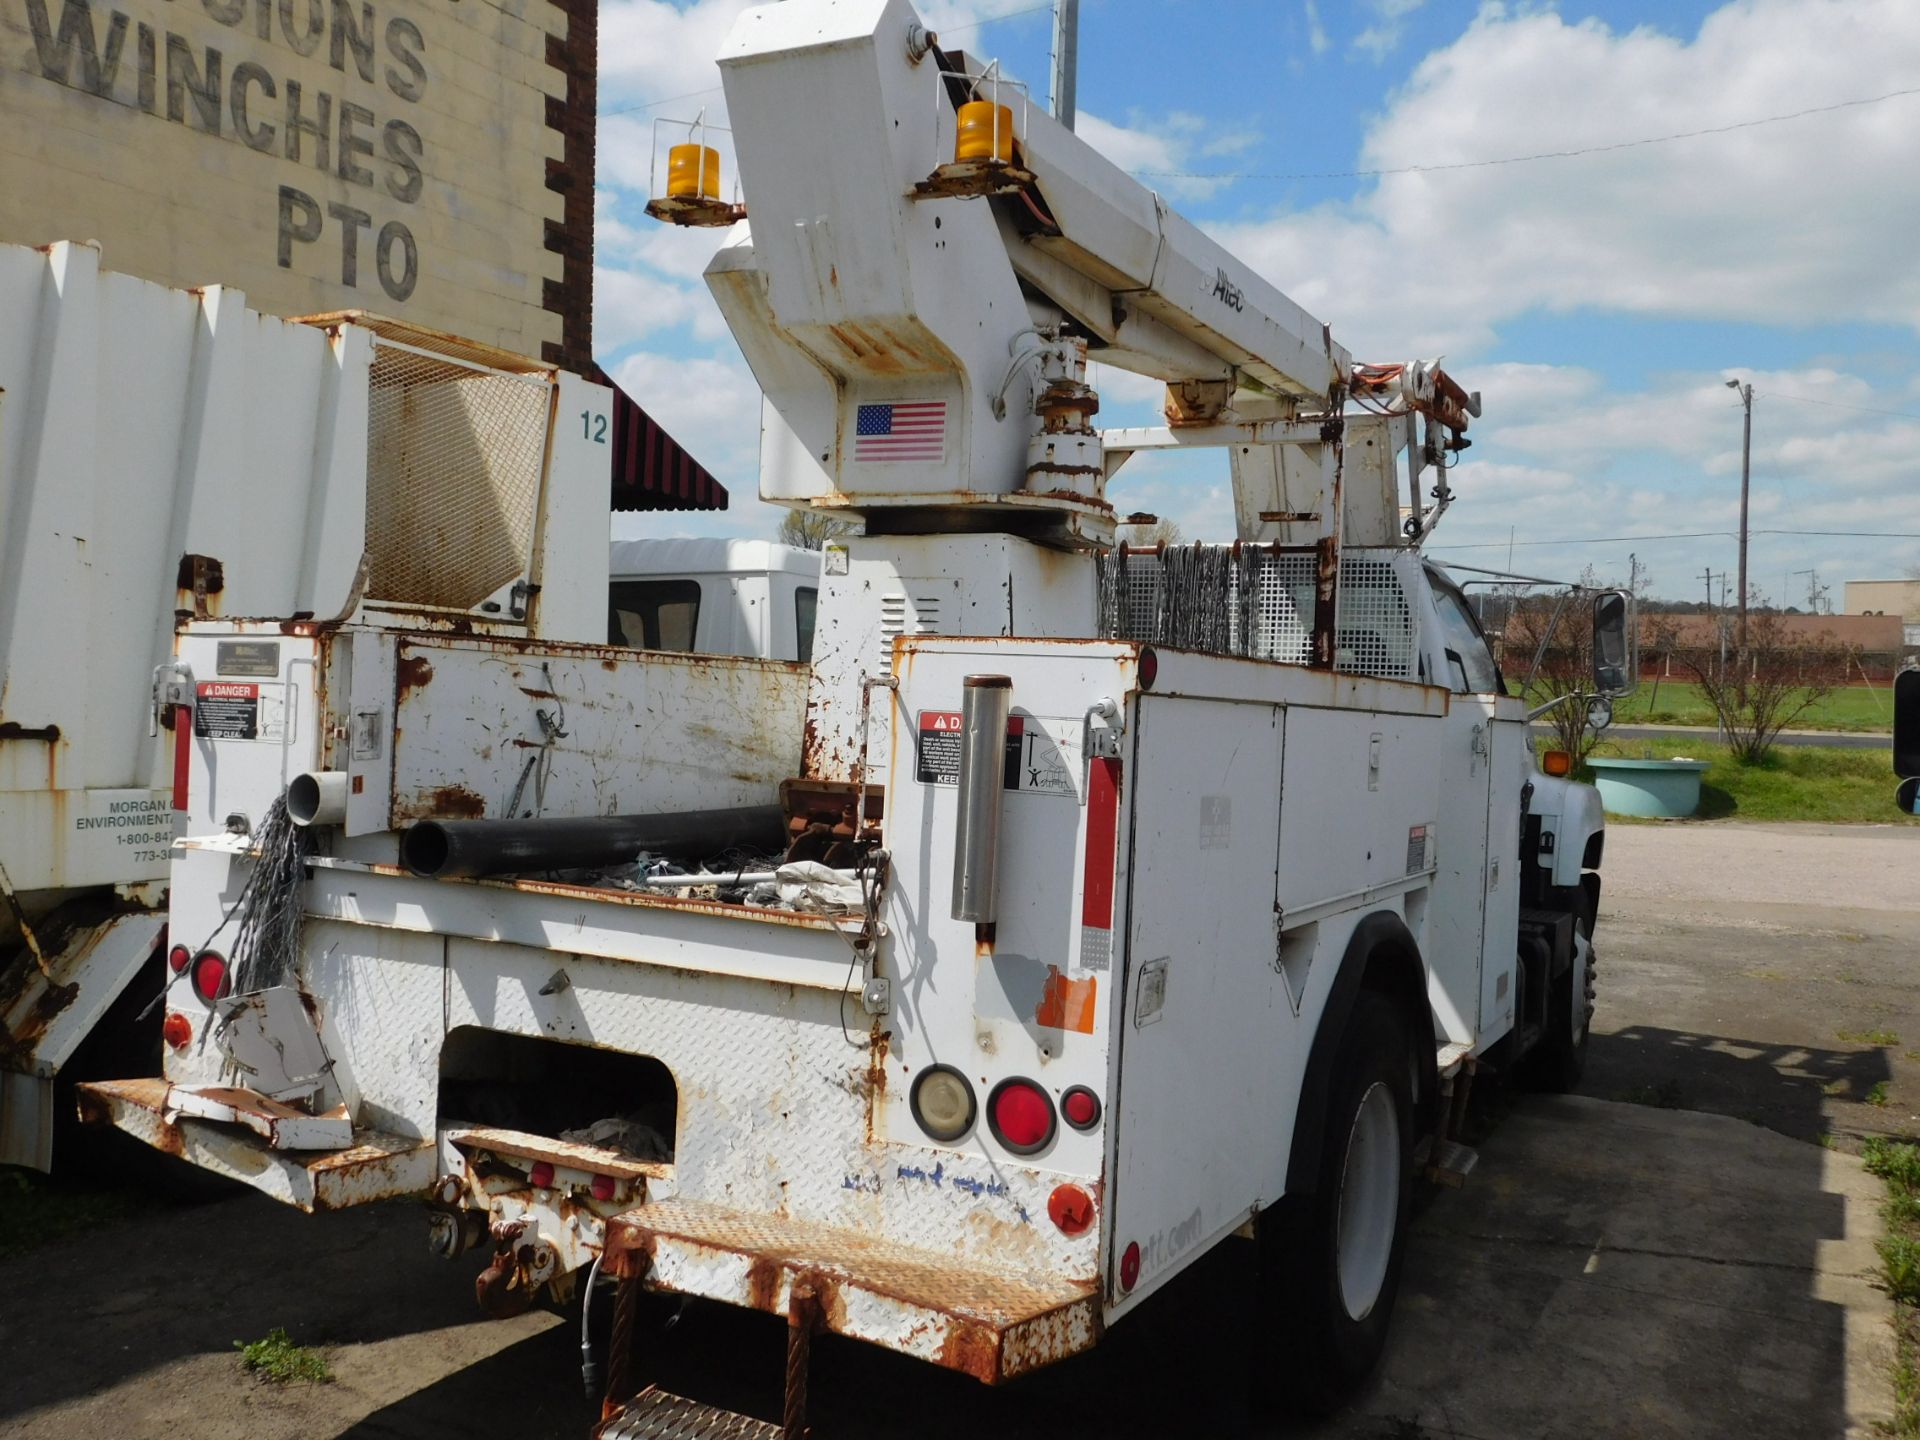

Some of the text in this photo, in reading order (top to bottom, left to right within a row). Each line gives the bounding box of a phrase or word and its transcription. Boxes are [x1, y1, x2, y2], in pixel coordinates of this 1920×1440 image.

[26, 0, 424, 204] WINCHES
[277, 184, 418, 302] PTO
[580, 410, 607, 444] 12
[214, 685, 251, 697] DANGER
[110, 801, 166, 814] MORGAN
[116, 831, 173, 845] 1-800-847
